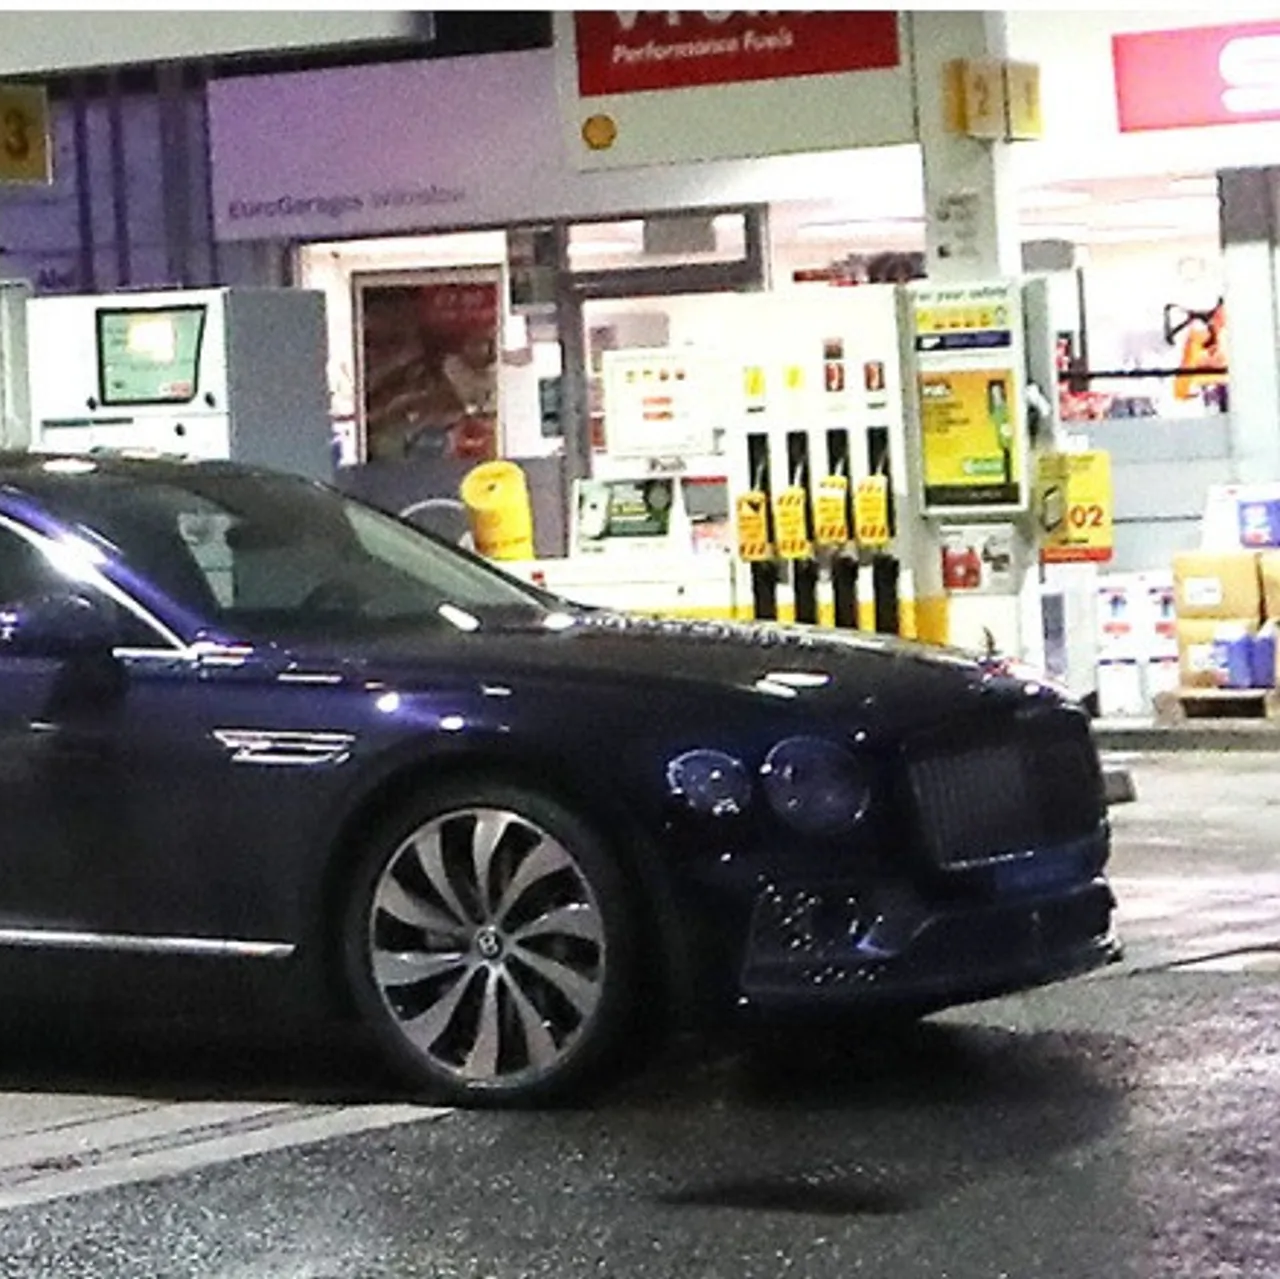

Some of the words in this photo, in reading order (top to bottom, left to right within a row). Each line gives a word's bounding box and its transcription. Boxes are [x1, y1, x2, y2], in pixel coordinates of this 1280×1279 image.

[613, 34, 739, 63] Performance
[743, 27, 793, 51] Fuels
[5, 108, 29, 161] 3
[228, 196, 364, 218] EuroGarages
[1070, 505, 1103, 527] 02
